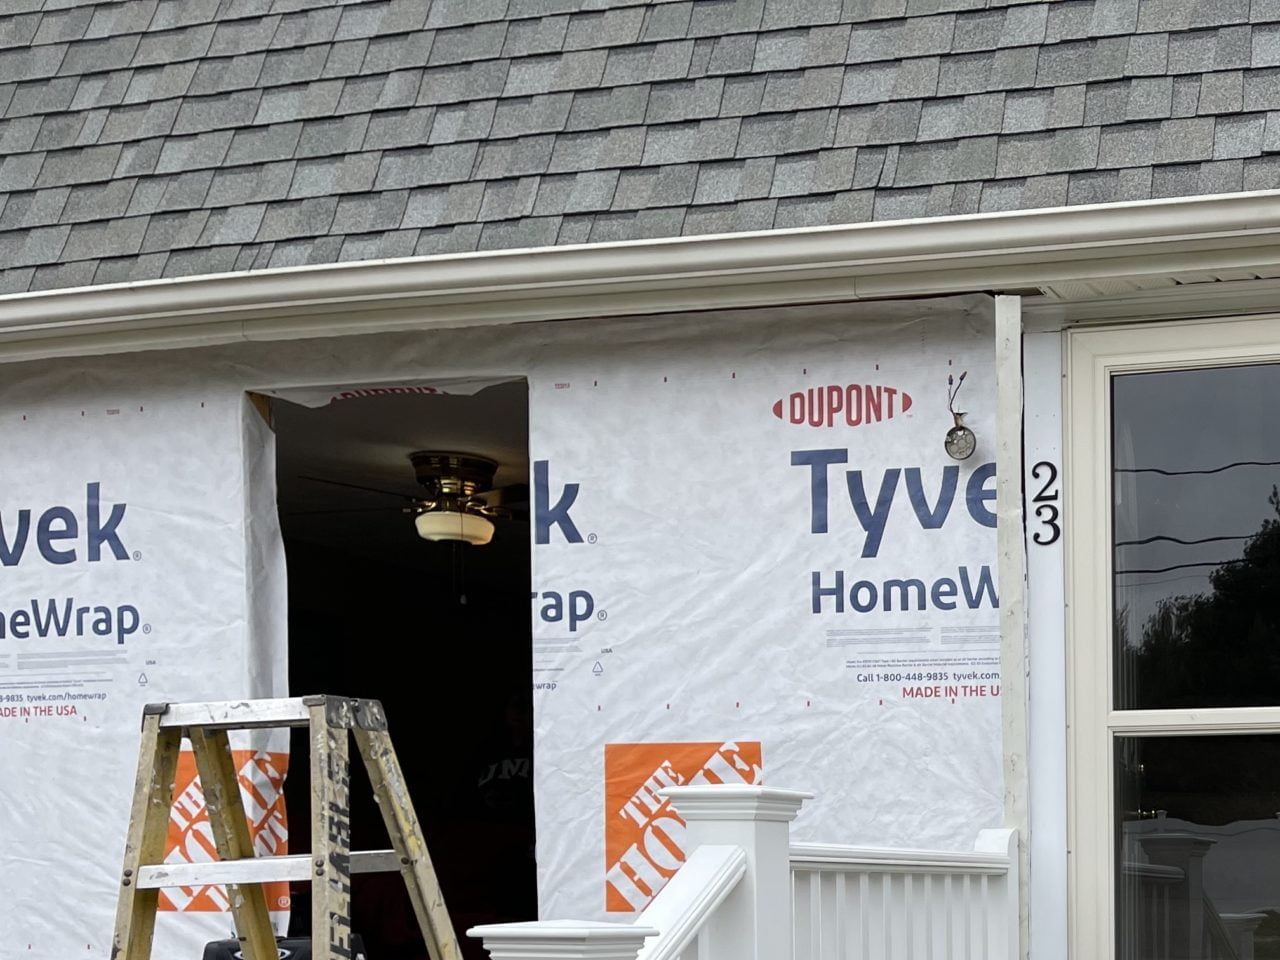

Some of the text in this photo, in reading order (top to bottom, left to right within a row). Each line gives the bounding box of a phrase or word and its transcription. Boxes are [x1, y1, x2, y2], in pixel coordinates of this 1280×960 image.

[790, 384, 897, 428] DUPONT
[856, 670, 1000, 683] Call 1-800-448-9835 tyvek.com
[27, 692, 107, 704] tyvek.com/homewrap
[902, 686, 941, 698] MADE
[945, 686, 958, 698] IN
[961, 685, 986, 697] THE
[20, 707, 30, 717] IN
[33, 706, 53, 717] THE
[56, 705, 77, 716] USA
[605, 742, 763, 912] HOE
